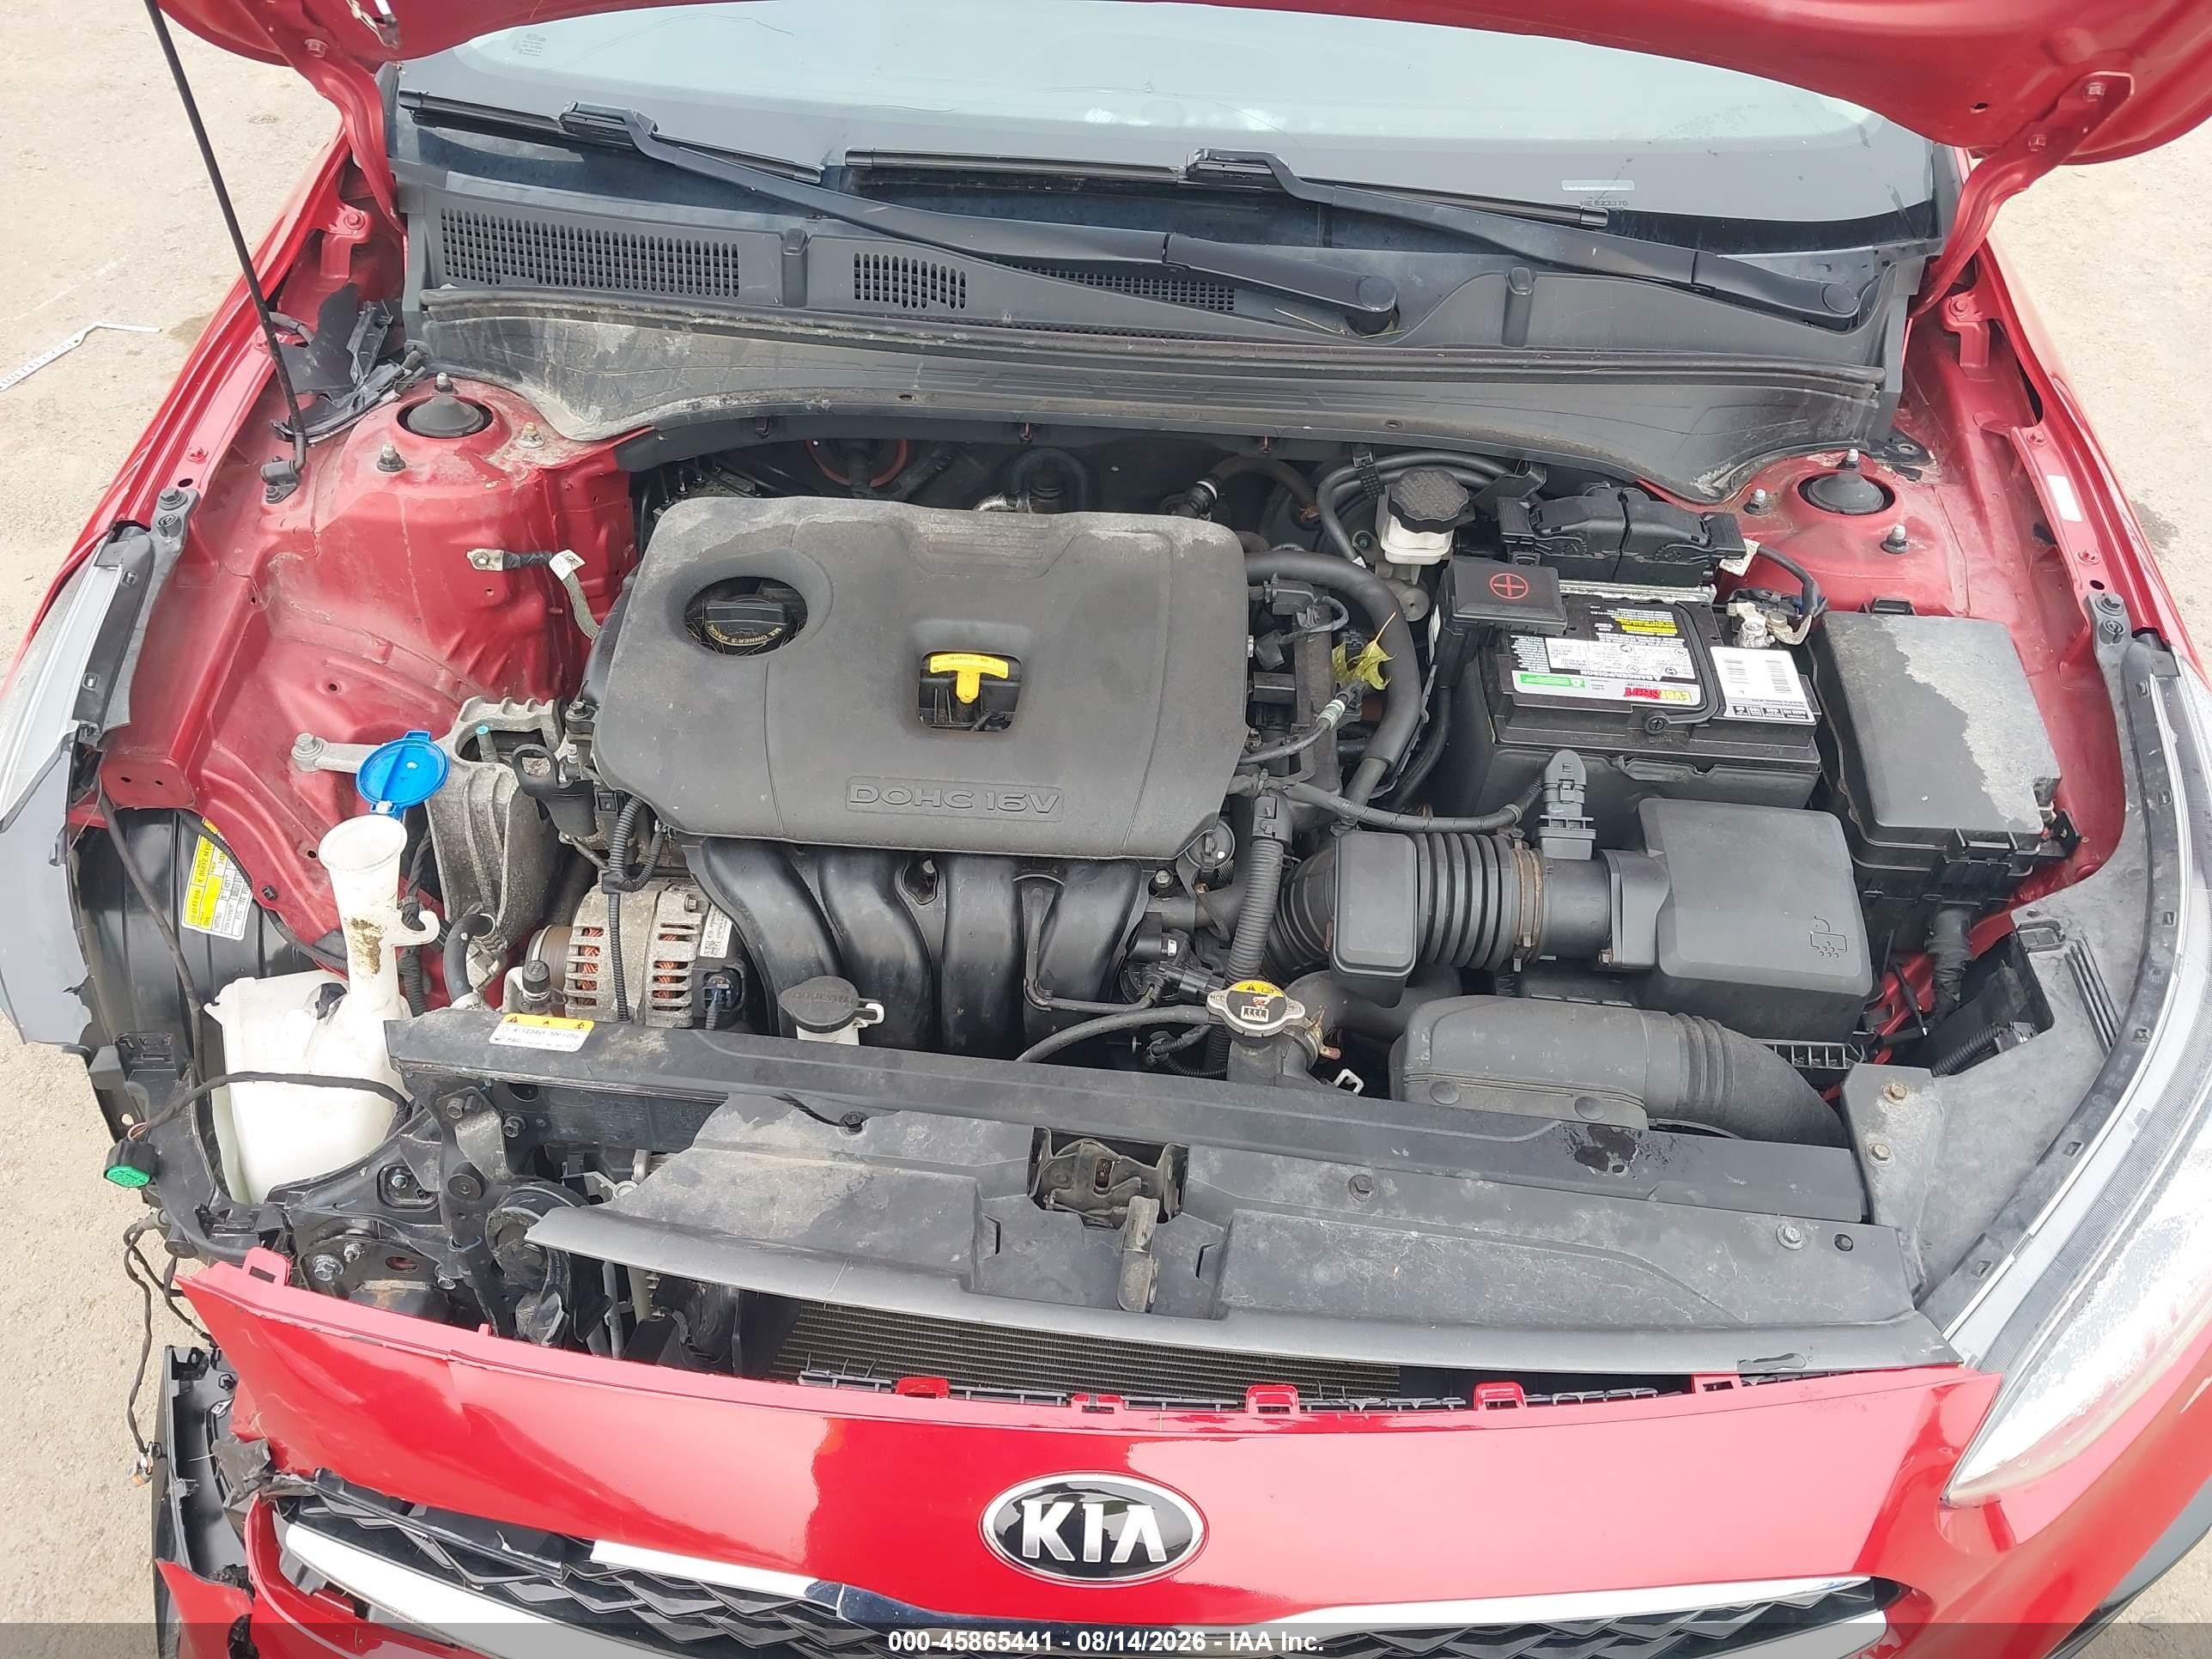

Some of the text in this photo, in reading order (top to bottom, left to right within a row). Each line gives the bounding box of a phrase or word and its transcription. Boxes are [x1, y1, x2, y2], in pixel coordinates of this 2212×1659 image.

[707, 624, 783, 643] SEE OWNER'S MANUAL
[848, 783, 1060, 814] DOHC 16V
[1022, 1499, 1168, 1564] KIA
